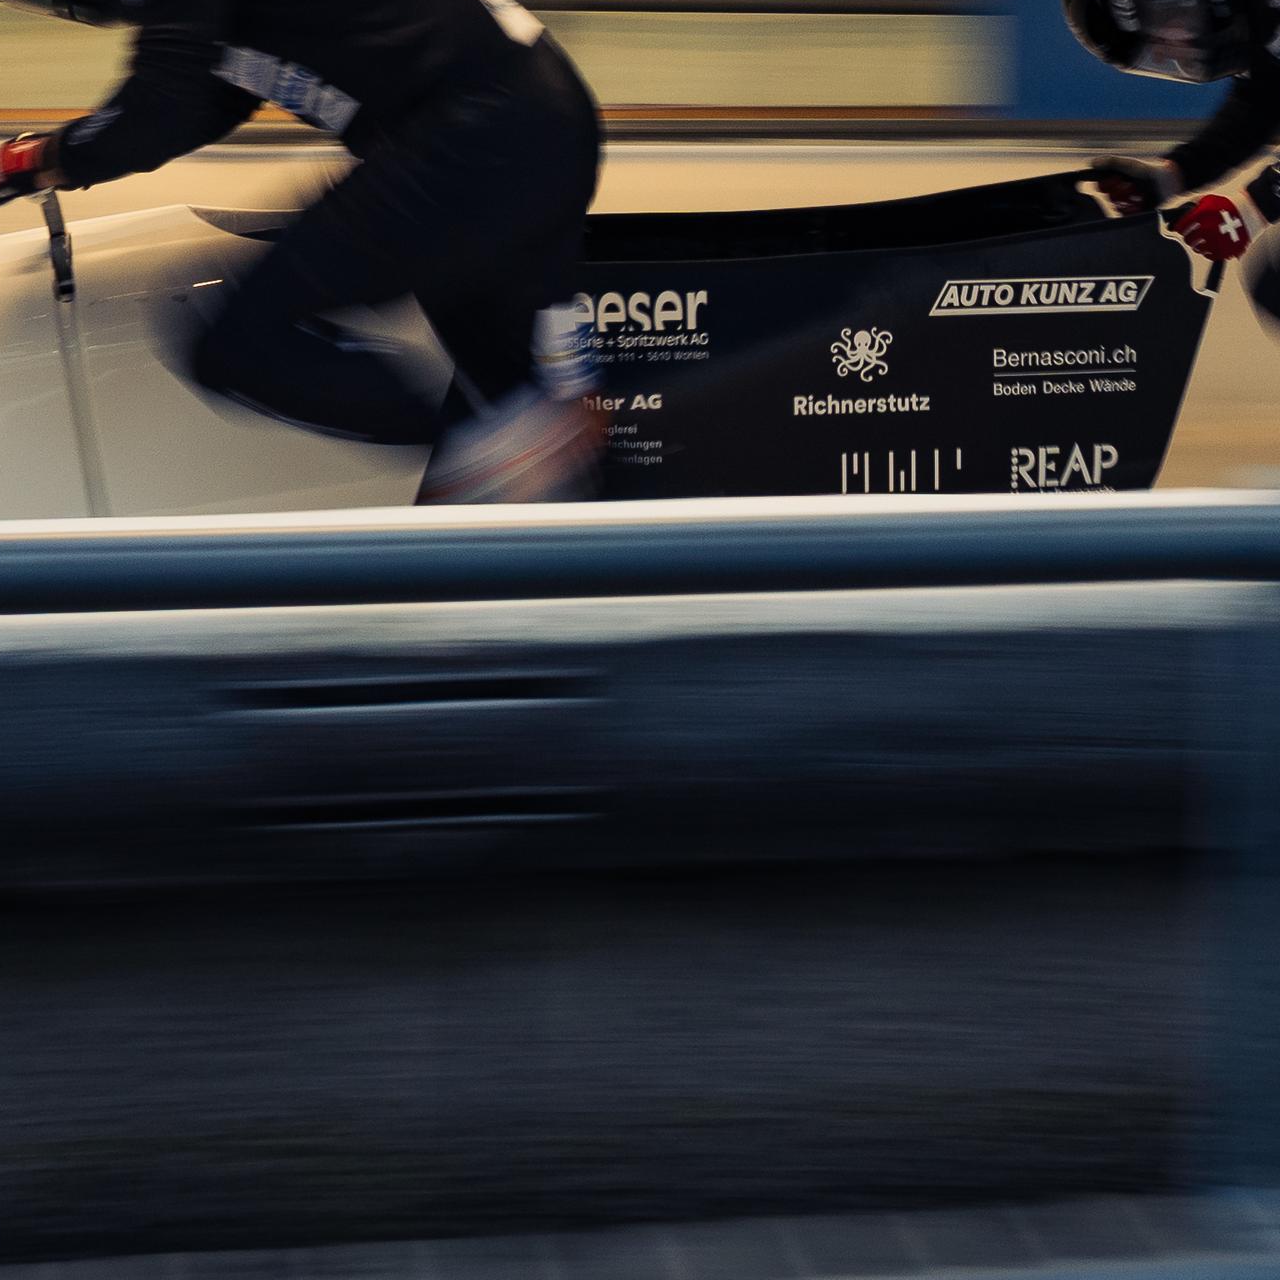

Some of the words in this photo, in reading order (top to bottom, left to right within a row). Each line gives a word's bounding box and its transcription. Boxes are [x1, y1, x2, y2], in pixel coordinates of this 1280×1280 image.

[940, 284, 1014, 308] AUTO
[1020, 282, 1096, 306] KUNZ
[1099, 281, 1139, 303] AG
[570, 290, 708, 333] eeser
[617, 333, 689, 349] Spritzwerk
[690, 332, 709, 346] AG
[993, 345, 1137, 367] Bernasconi.ch
[993, 381, 1037, 396] Boden
[1043, 380, 1085, 394] Decke
[1091, 378, 1137, 393] Wände
[582, 396, 626, 411] hler
[630, 394, 663, 410] AG
[793, 393, 931, 416] Richnerstutz
[601, 424, 638, 436] nglerei
[622, 453, 663, 465] anlagen
[1010, 442, 1119, 489] REAP
